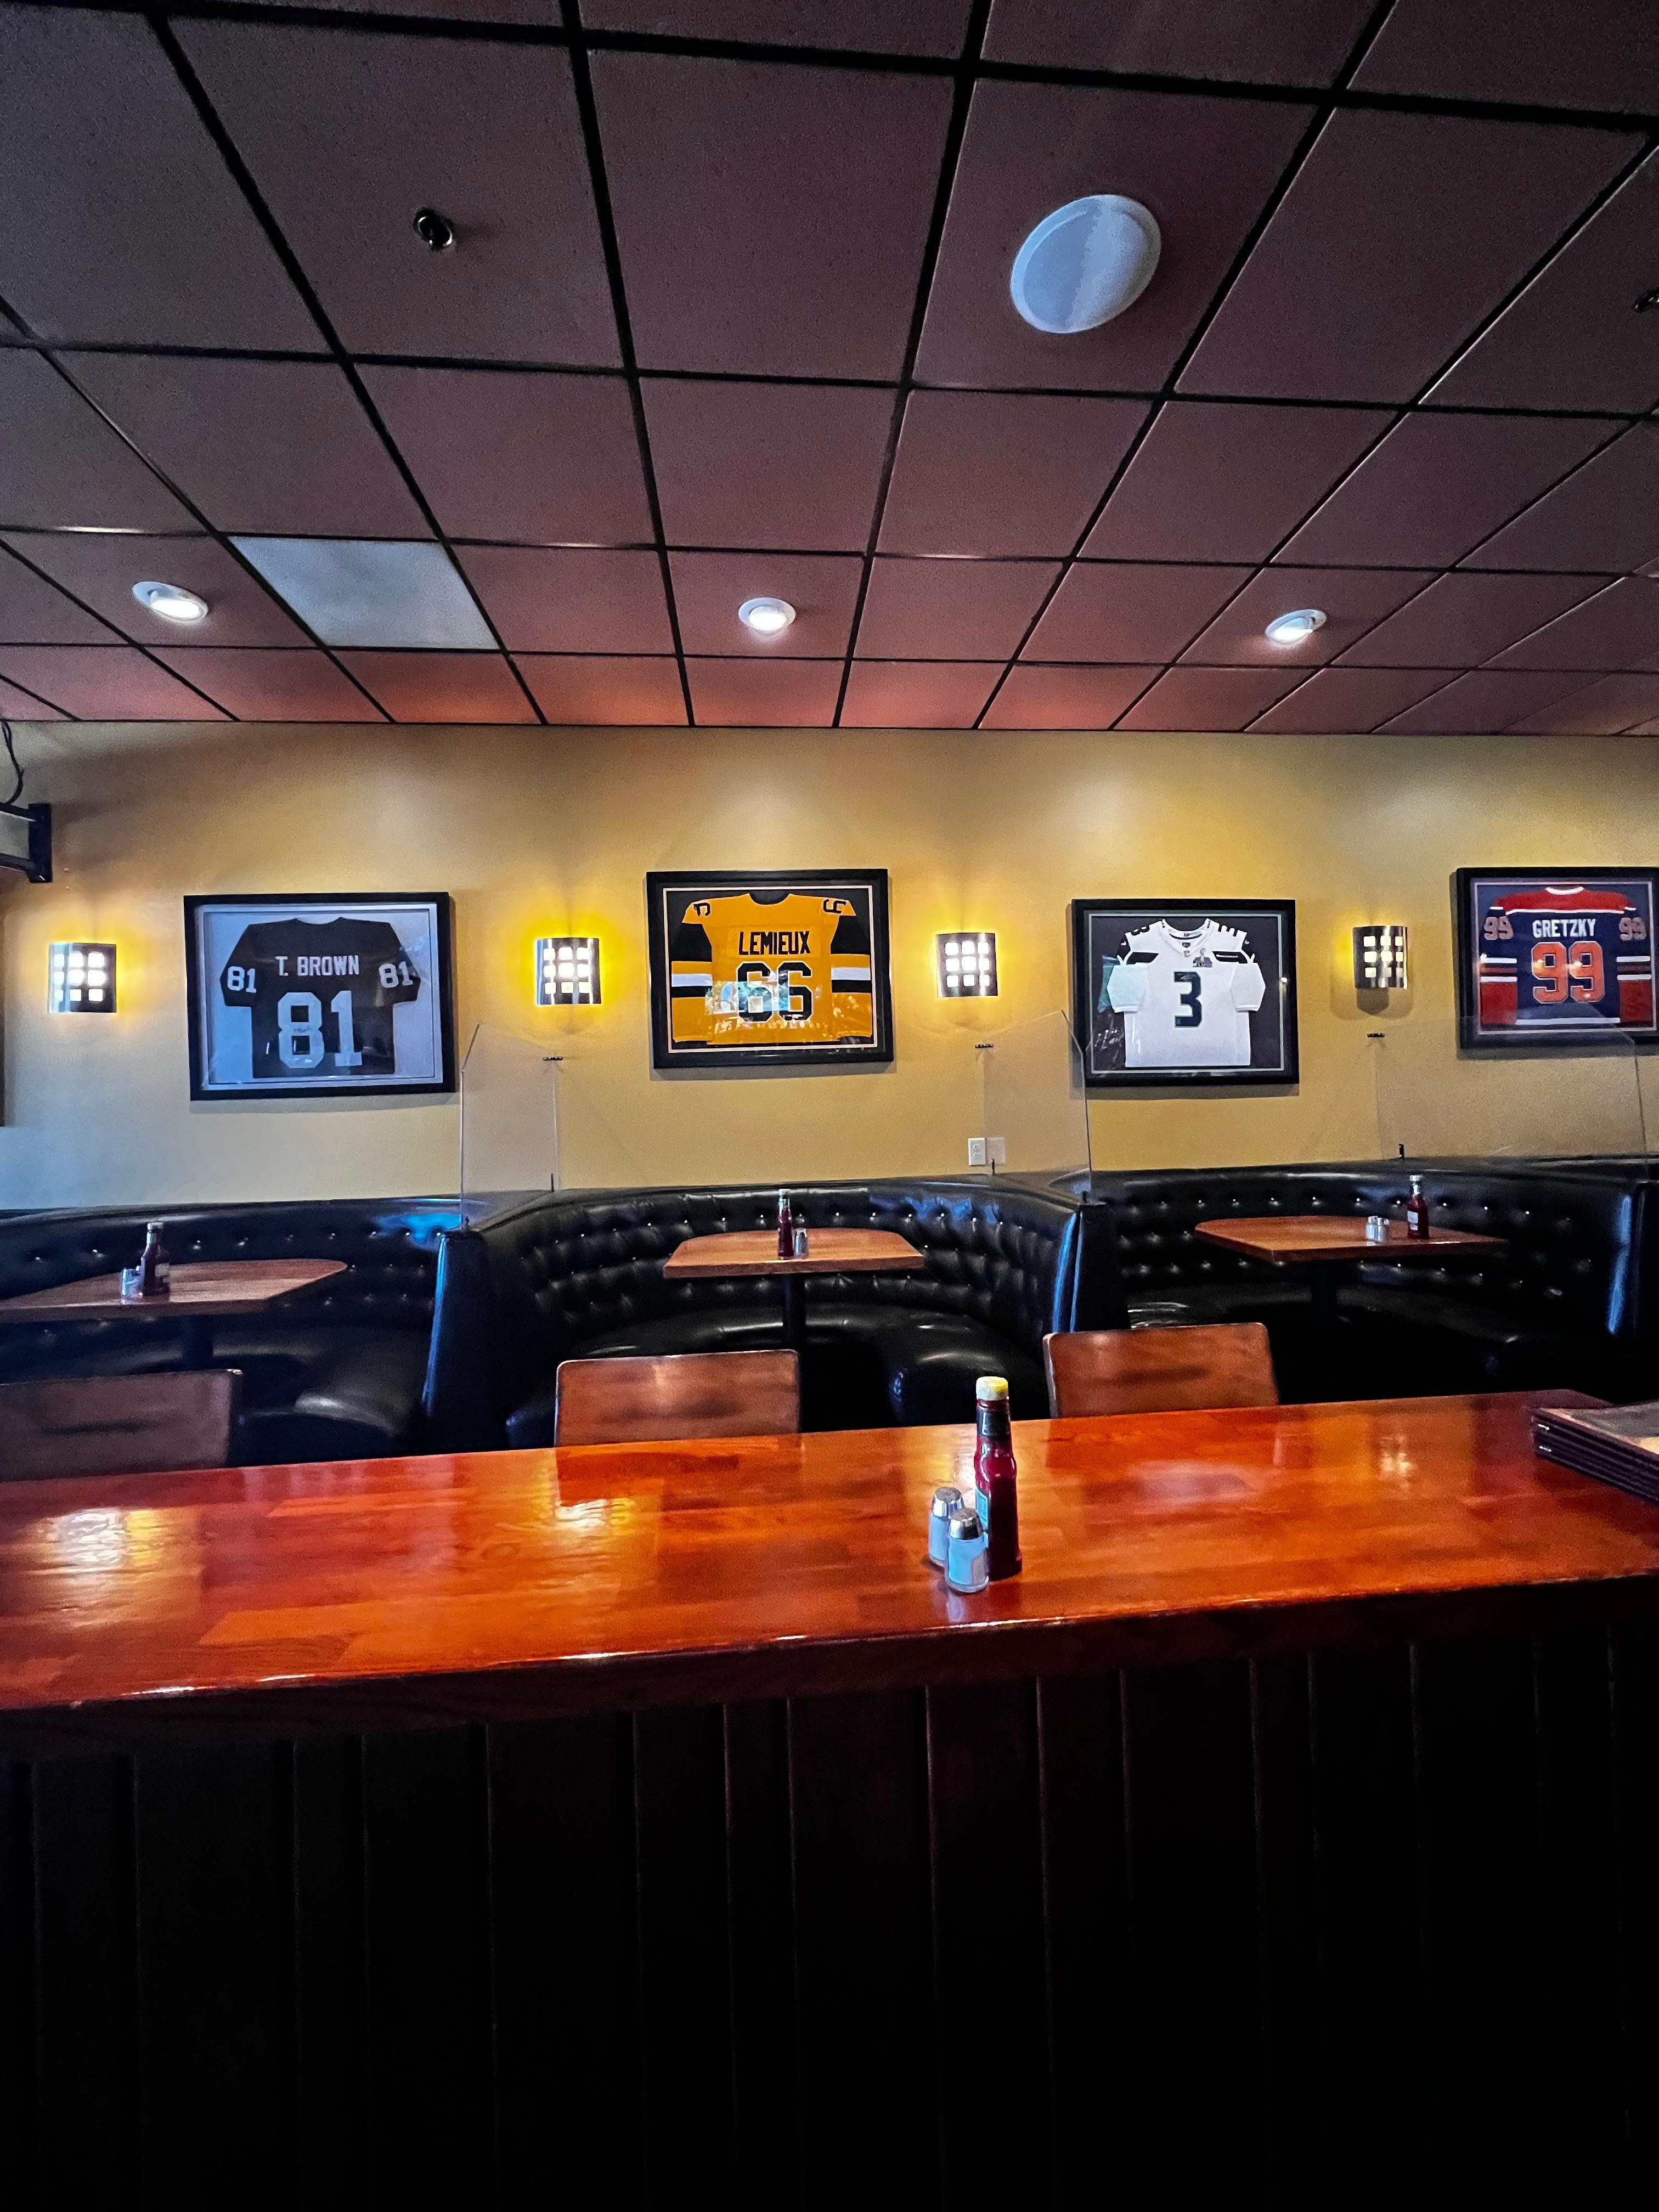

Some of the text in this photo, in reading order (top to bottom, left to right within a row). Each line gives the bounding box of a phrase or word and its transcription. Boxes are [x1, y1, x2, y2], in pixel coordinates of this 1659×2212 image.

[1484, 916, 1514, 940] 99
[1532, 919, 1596, 938] GRETZKY
[738, 930, 811, 956] LEMIEUX
[275, 955, 359, 976] T. BROWN
[379, 961, 413, 988] 81
[1531, 941, 1605, 1004] 99
[227, 966, 256, 993] 81
[736, 961, 813, 1023] 66
[1173, 970, 1202, 1028] 3
[278, 991, 362, 1069] 81
